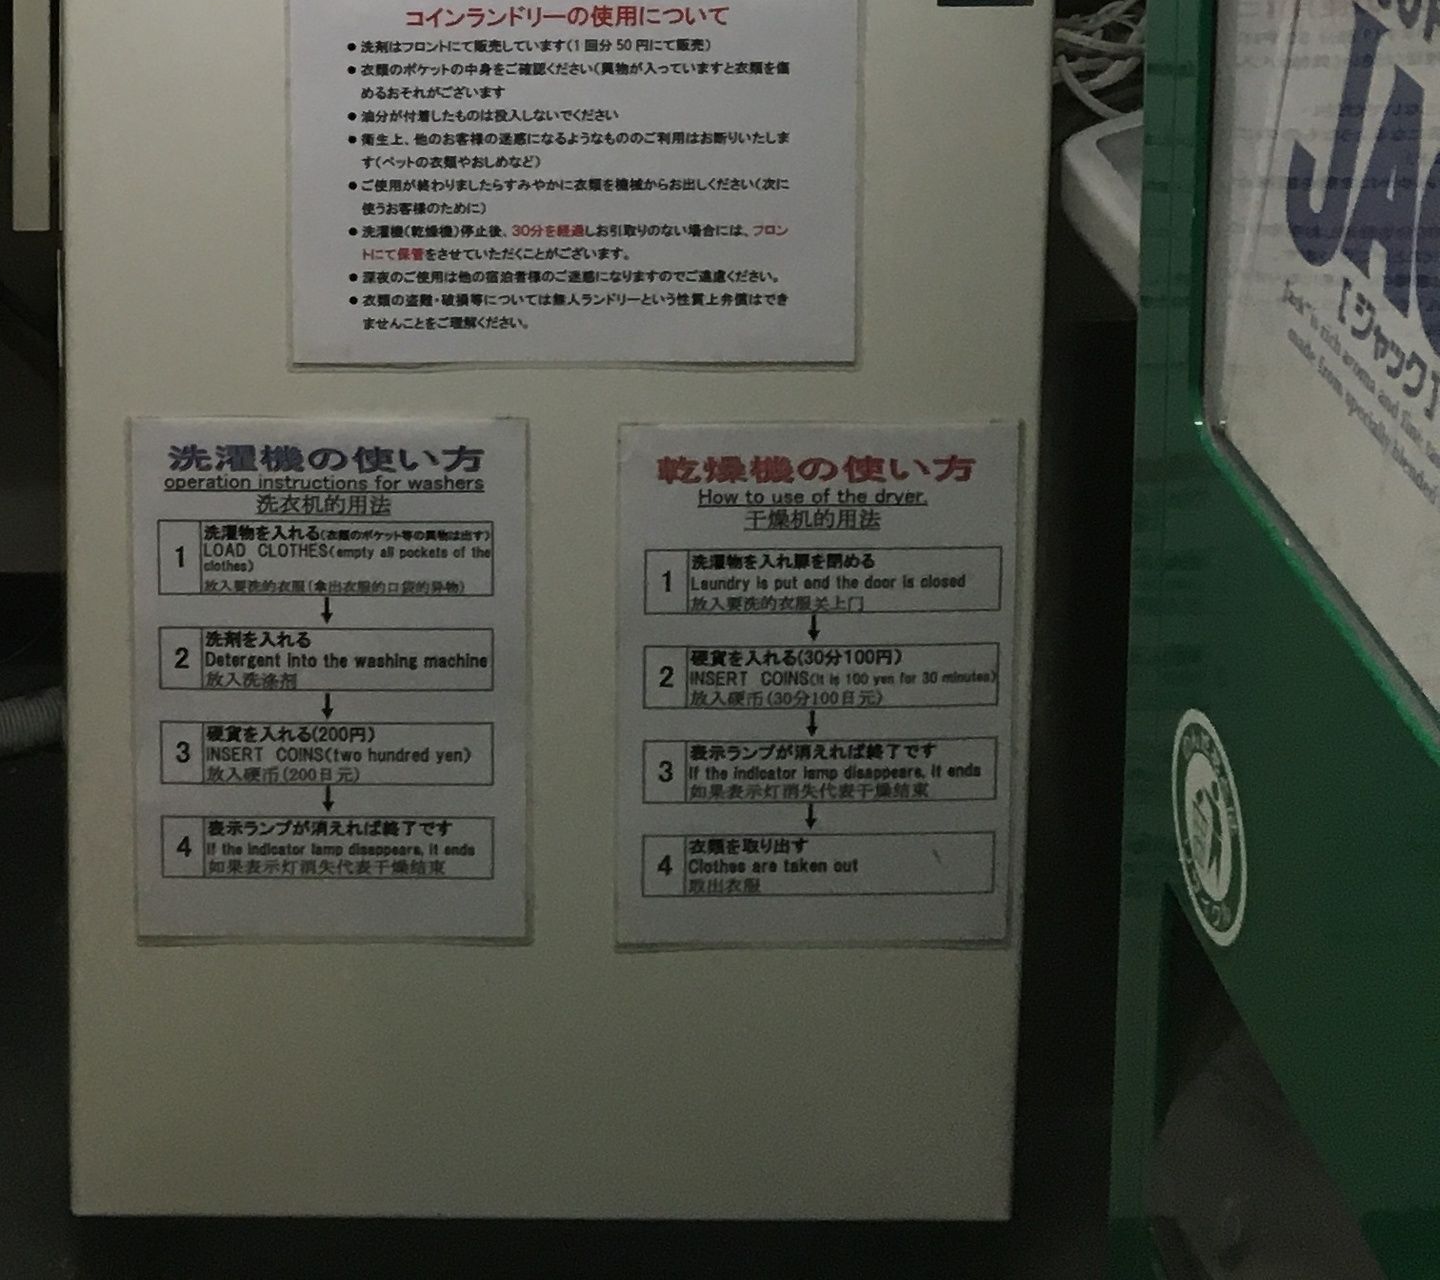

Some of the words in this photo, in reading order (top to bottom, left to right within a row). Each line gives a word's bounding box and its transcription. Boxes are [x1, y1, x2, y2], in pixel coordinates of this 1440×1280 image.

[405, 5, 730, 28] コインランドリーの使用について
[361, 85, 506, 100] めるおそれがございます
[361, 108, 618, 123] 油分が付着したものは投入しないでください
[168, 445, 484, 472] 洗濯機の使い方
[657, 454, 976, 484] 乾燥機の使い方
[164, 475, 251, 492] operation
[258, 474, 367, 490] instructions
[375, 474, 402, 489] for
[408, 476, 484, 490] washers
[257, 495, 391, 515] 洗衣机的用法
[698, 489, 739, 505] How
[746, 489, 764, 504] to
[772, 492, 805, 504] use
[812, 488, 830, 504] of
[837, 488, 867, 504] the
[874, 488, 926, 506] dryer.
[746, 509, 881, 530] 干燥机的用法
[690, 575, 750, 591] Laundry
[757, 575, 769, 589] is
[775, 576, 798, 591] put
[805, 575, 830, 589] and
[836, 575, 858, 589] the
[864, 575, 896, 589] door
[903, 575, 915, 588] is
[921, 574, 966, 588] closed
[206, 631, 311, 648] 洗剤を入れる
[175, 647, 189, 668] 2
[206, 747, 262, 763] INSERT
[368, 747, 430, 763] hundred
